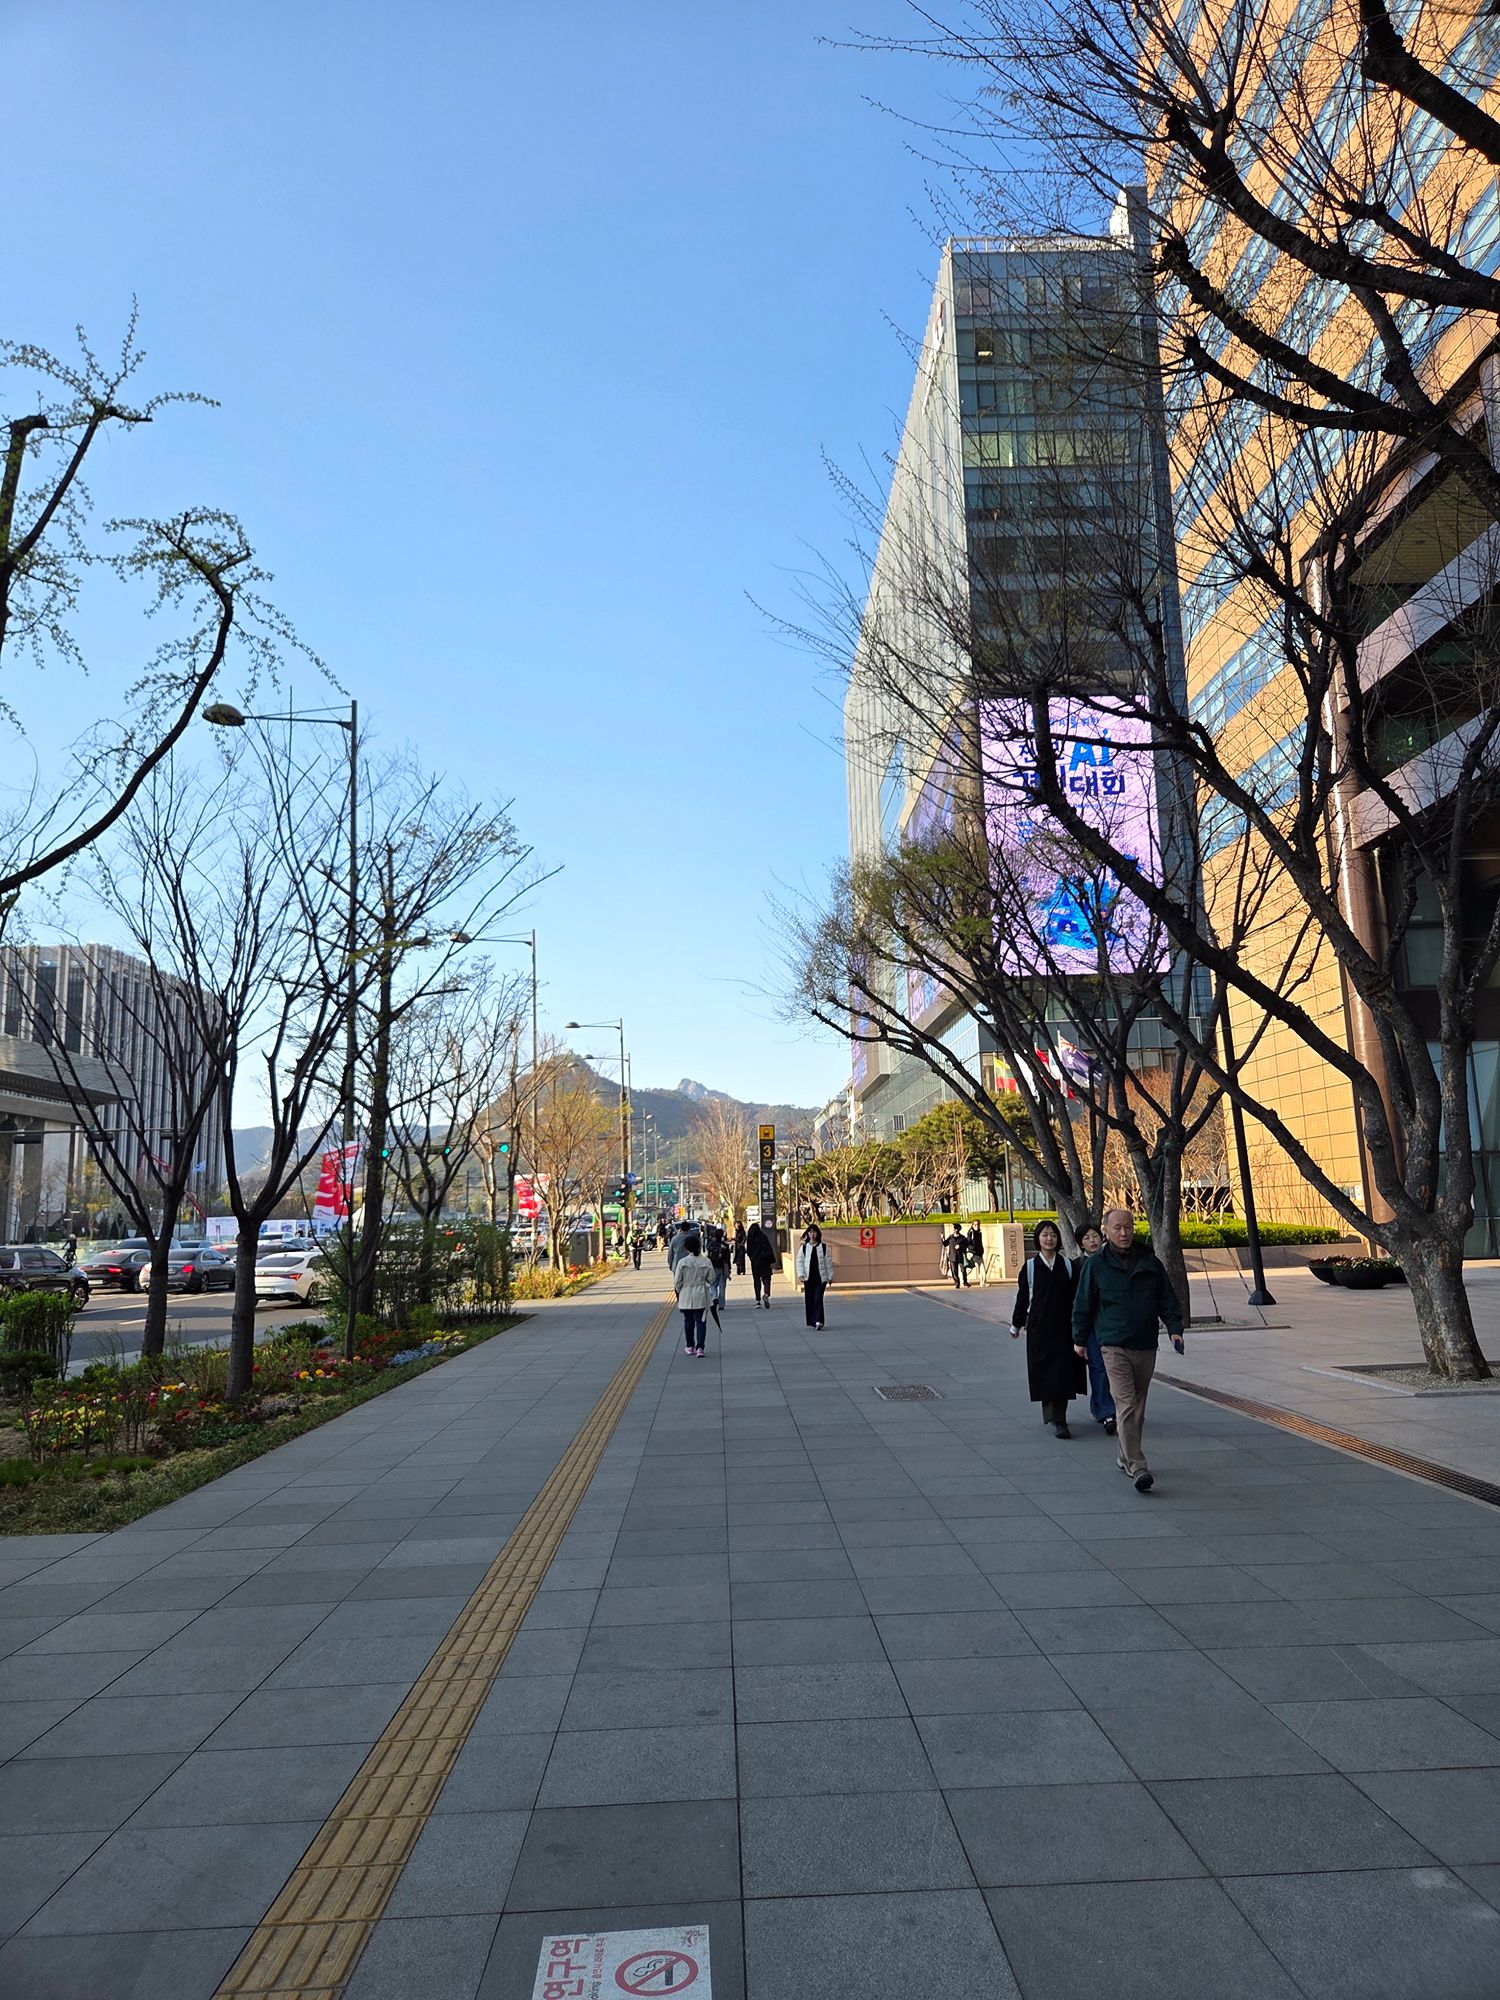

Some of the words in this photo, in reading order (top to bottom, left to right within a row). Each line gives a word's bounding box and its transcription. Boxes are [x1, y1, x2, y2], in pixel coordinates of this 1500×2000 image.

[1012, 764, 1126, 802] 경대회
[763, 1145, 771, 1157] 3
[543, 1938, 590, 2000] 연구역
